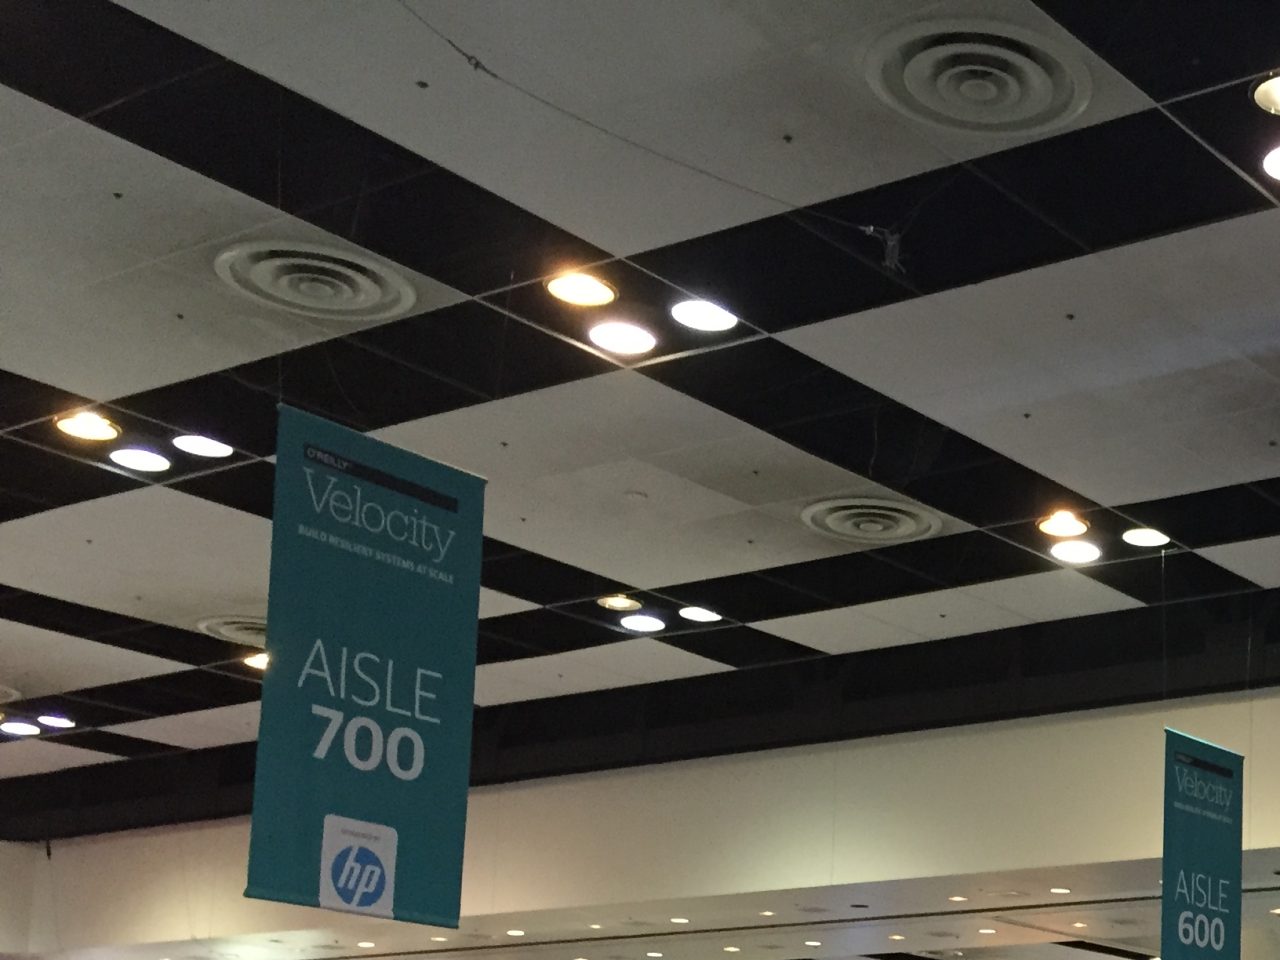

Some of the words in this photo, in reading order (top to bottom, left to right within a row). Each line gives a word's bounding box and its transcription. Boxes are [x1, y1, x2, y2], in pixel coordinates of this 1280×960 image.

[302, 466, 456, 562] Velocity
[298, 638, 442, 724] AISLE
[311, 703, 425, 781] 700
[1174, 764, 1233, 812] Velocity
[333, 846, 385, 907] hp
[1175, 869, 1230, 913] AISLE
[1178, 911, 1225, 950] 600
